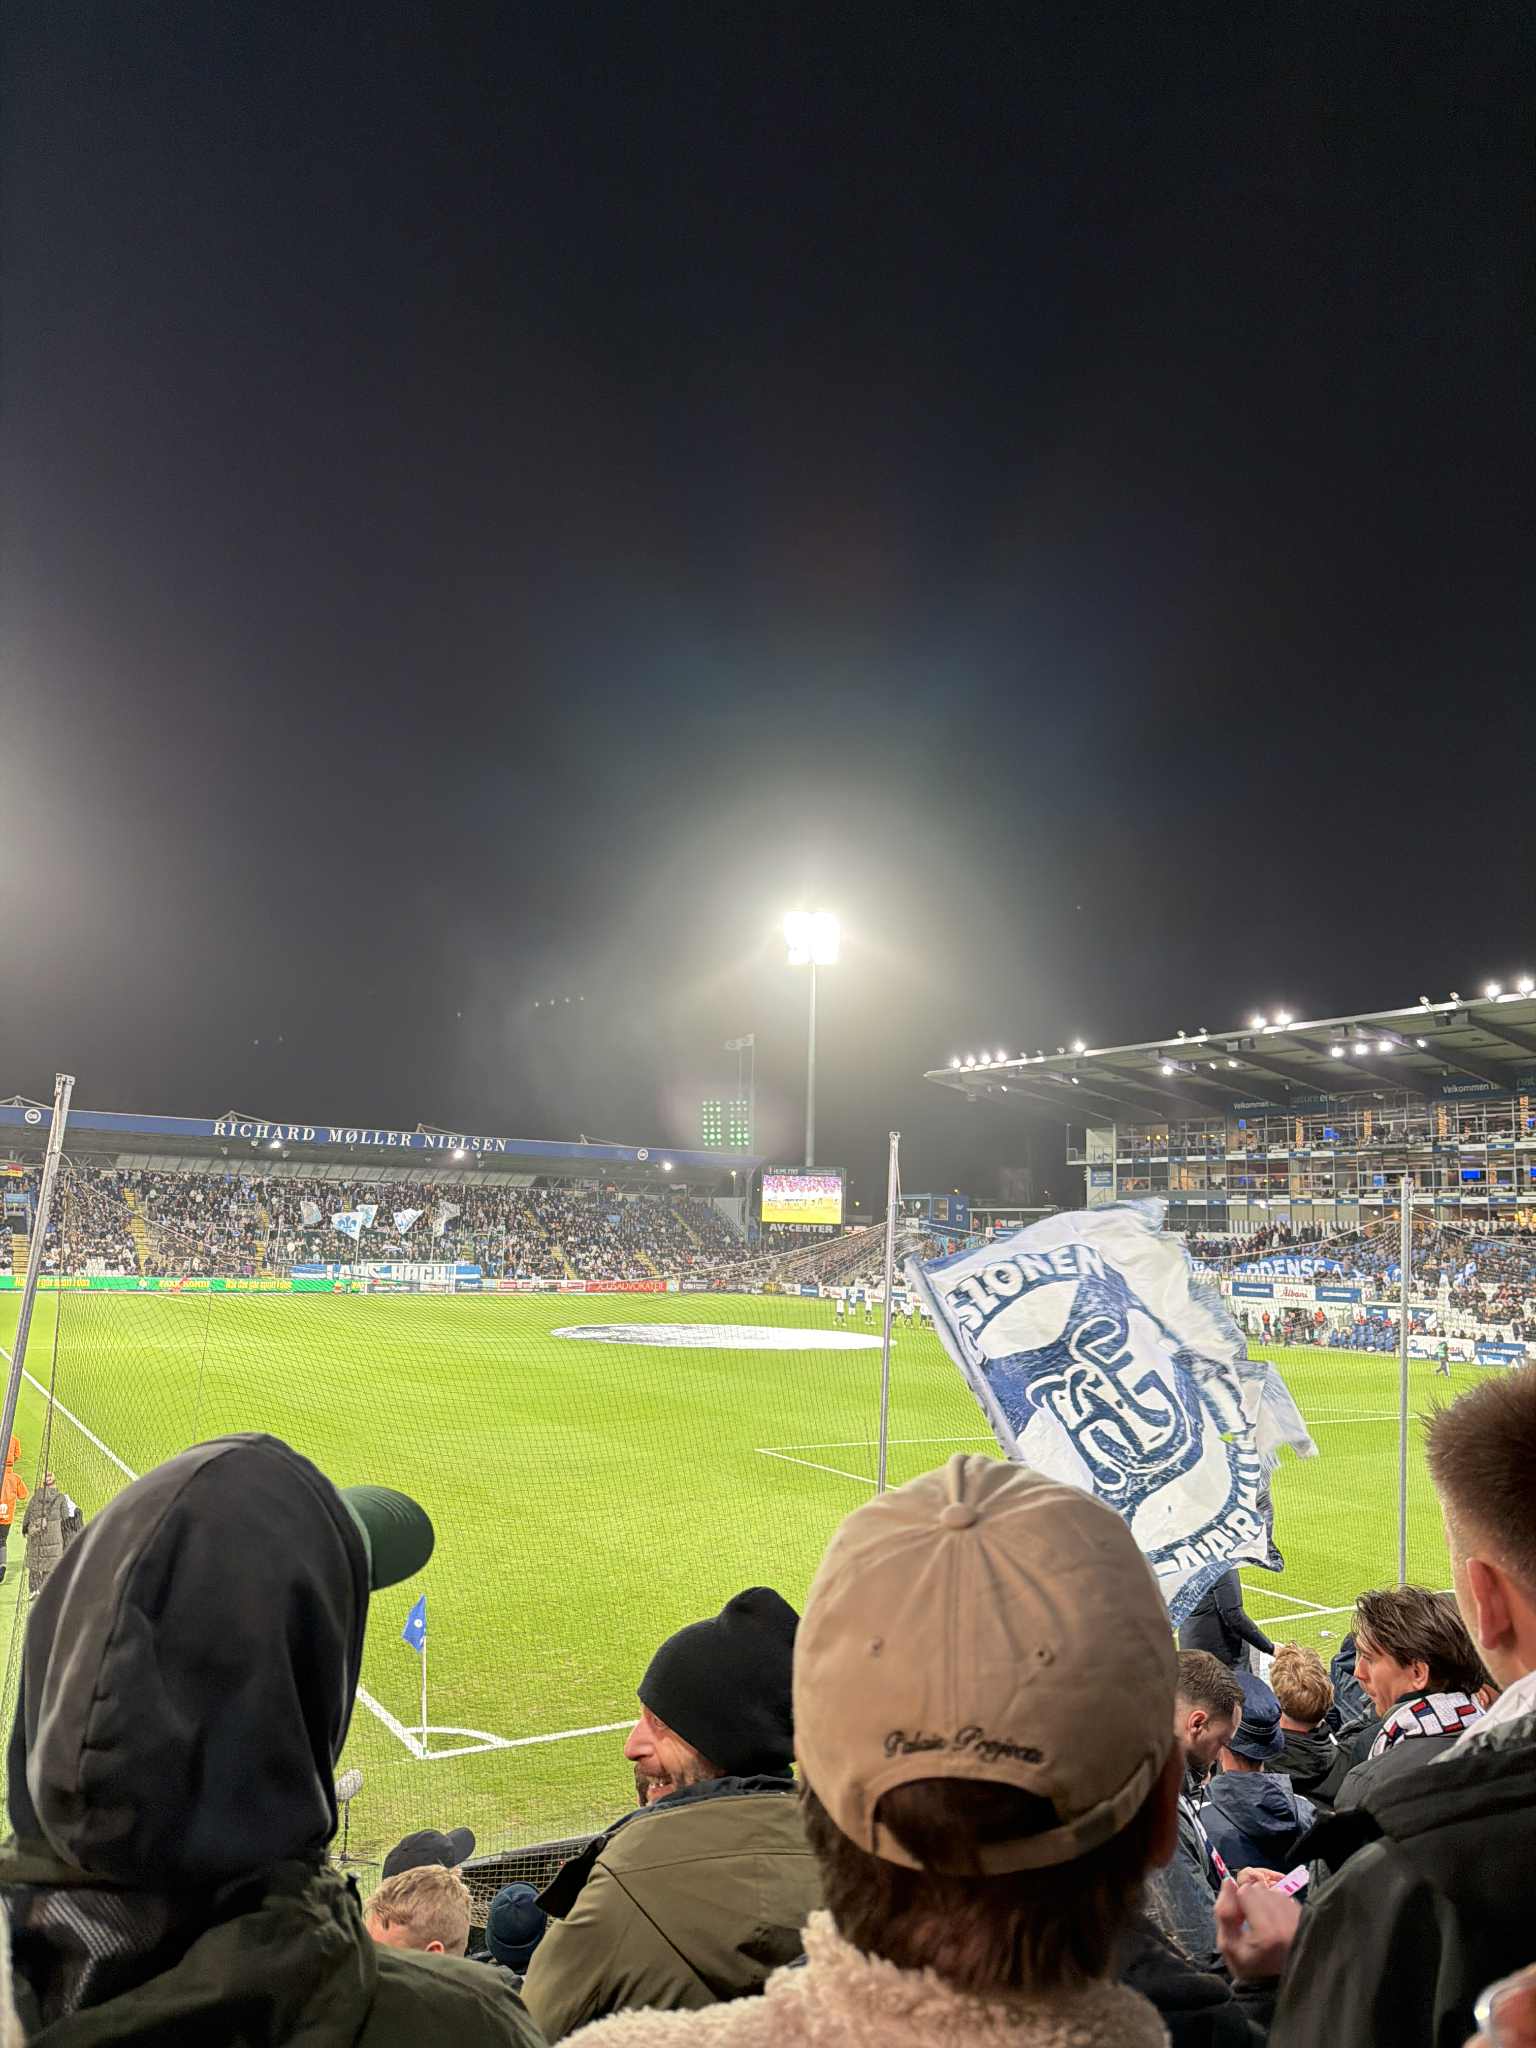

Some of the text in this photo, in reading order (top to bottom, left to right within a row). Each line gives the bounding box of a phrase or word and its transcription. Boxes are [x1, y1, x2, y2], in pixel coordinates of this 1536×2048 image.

[1442, 1083, 1489, 1094] Velkommen
[213, 1121, 507, 1152] RICHARD MØLLER NIELSEN
